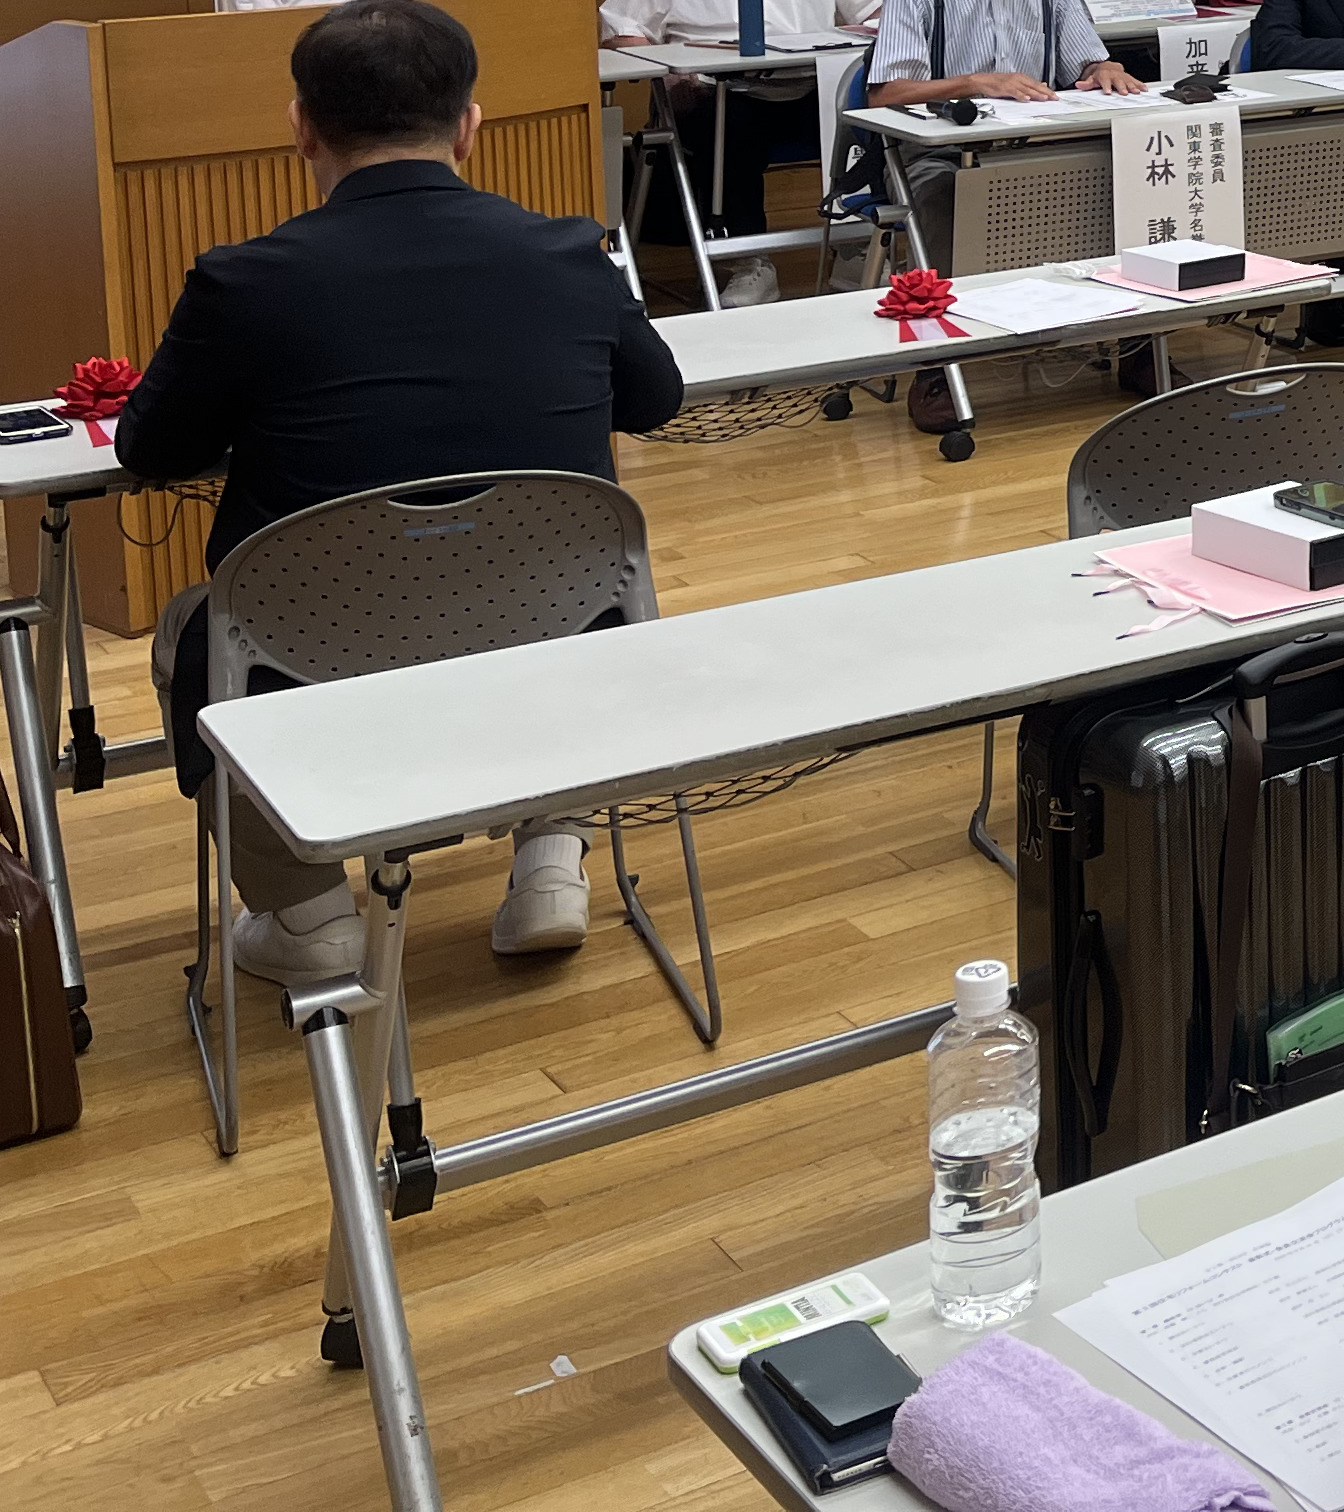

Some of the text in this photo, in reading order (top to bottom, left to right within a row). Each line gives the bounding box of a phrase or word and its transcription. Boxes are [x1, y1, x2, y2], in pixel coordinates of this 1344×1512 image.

[1145, 131, 1176, 186] 小林
[1209, 121, 1226, 184] 審査委員
